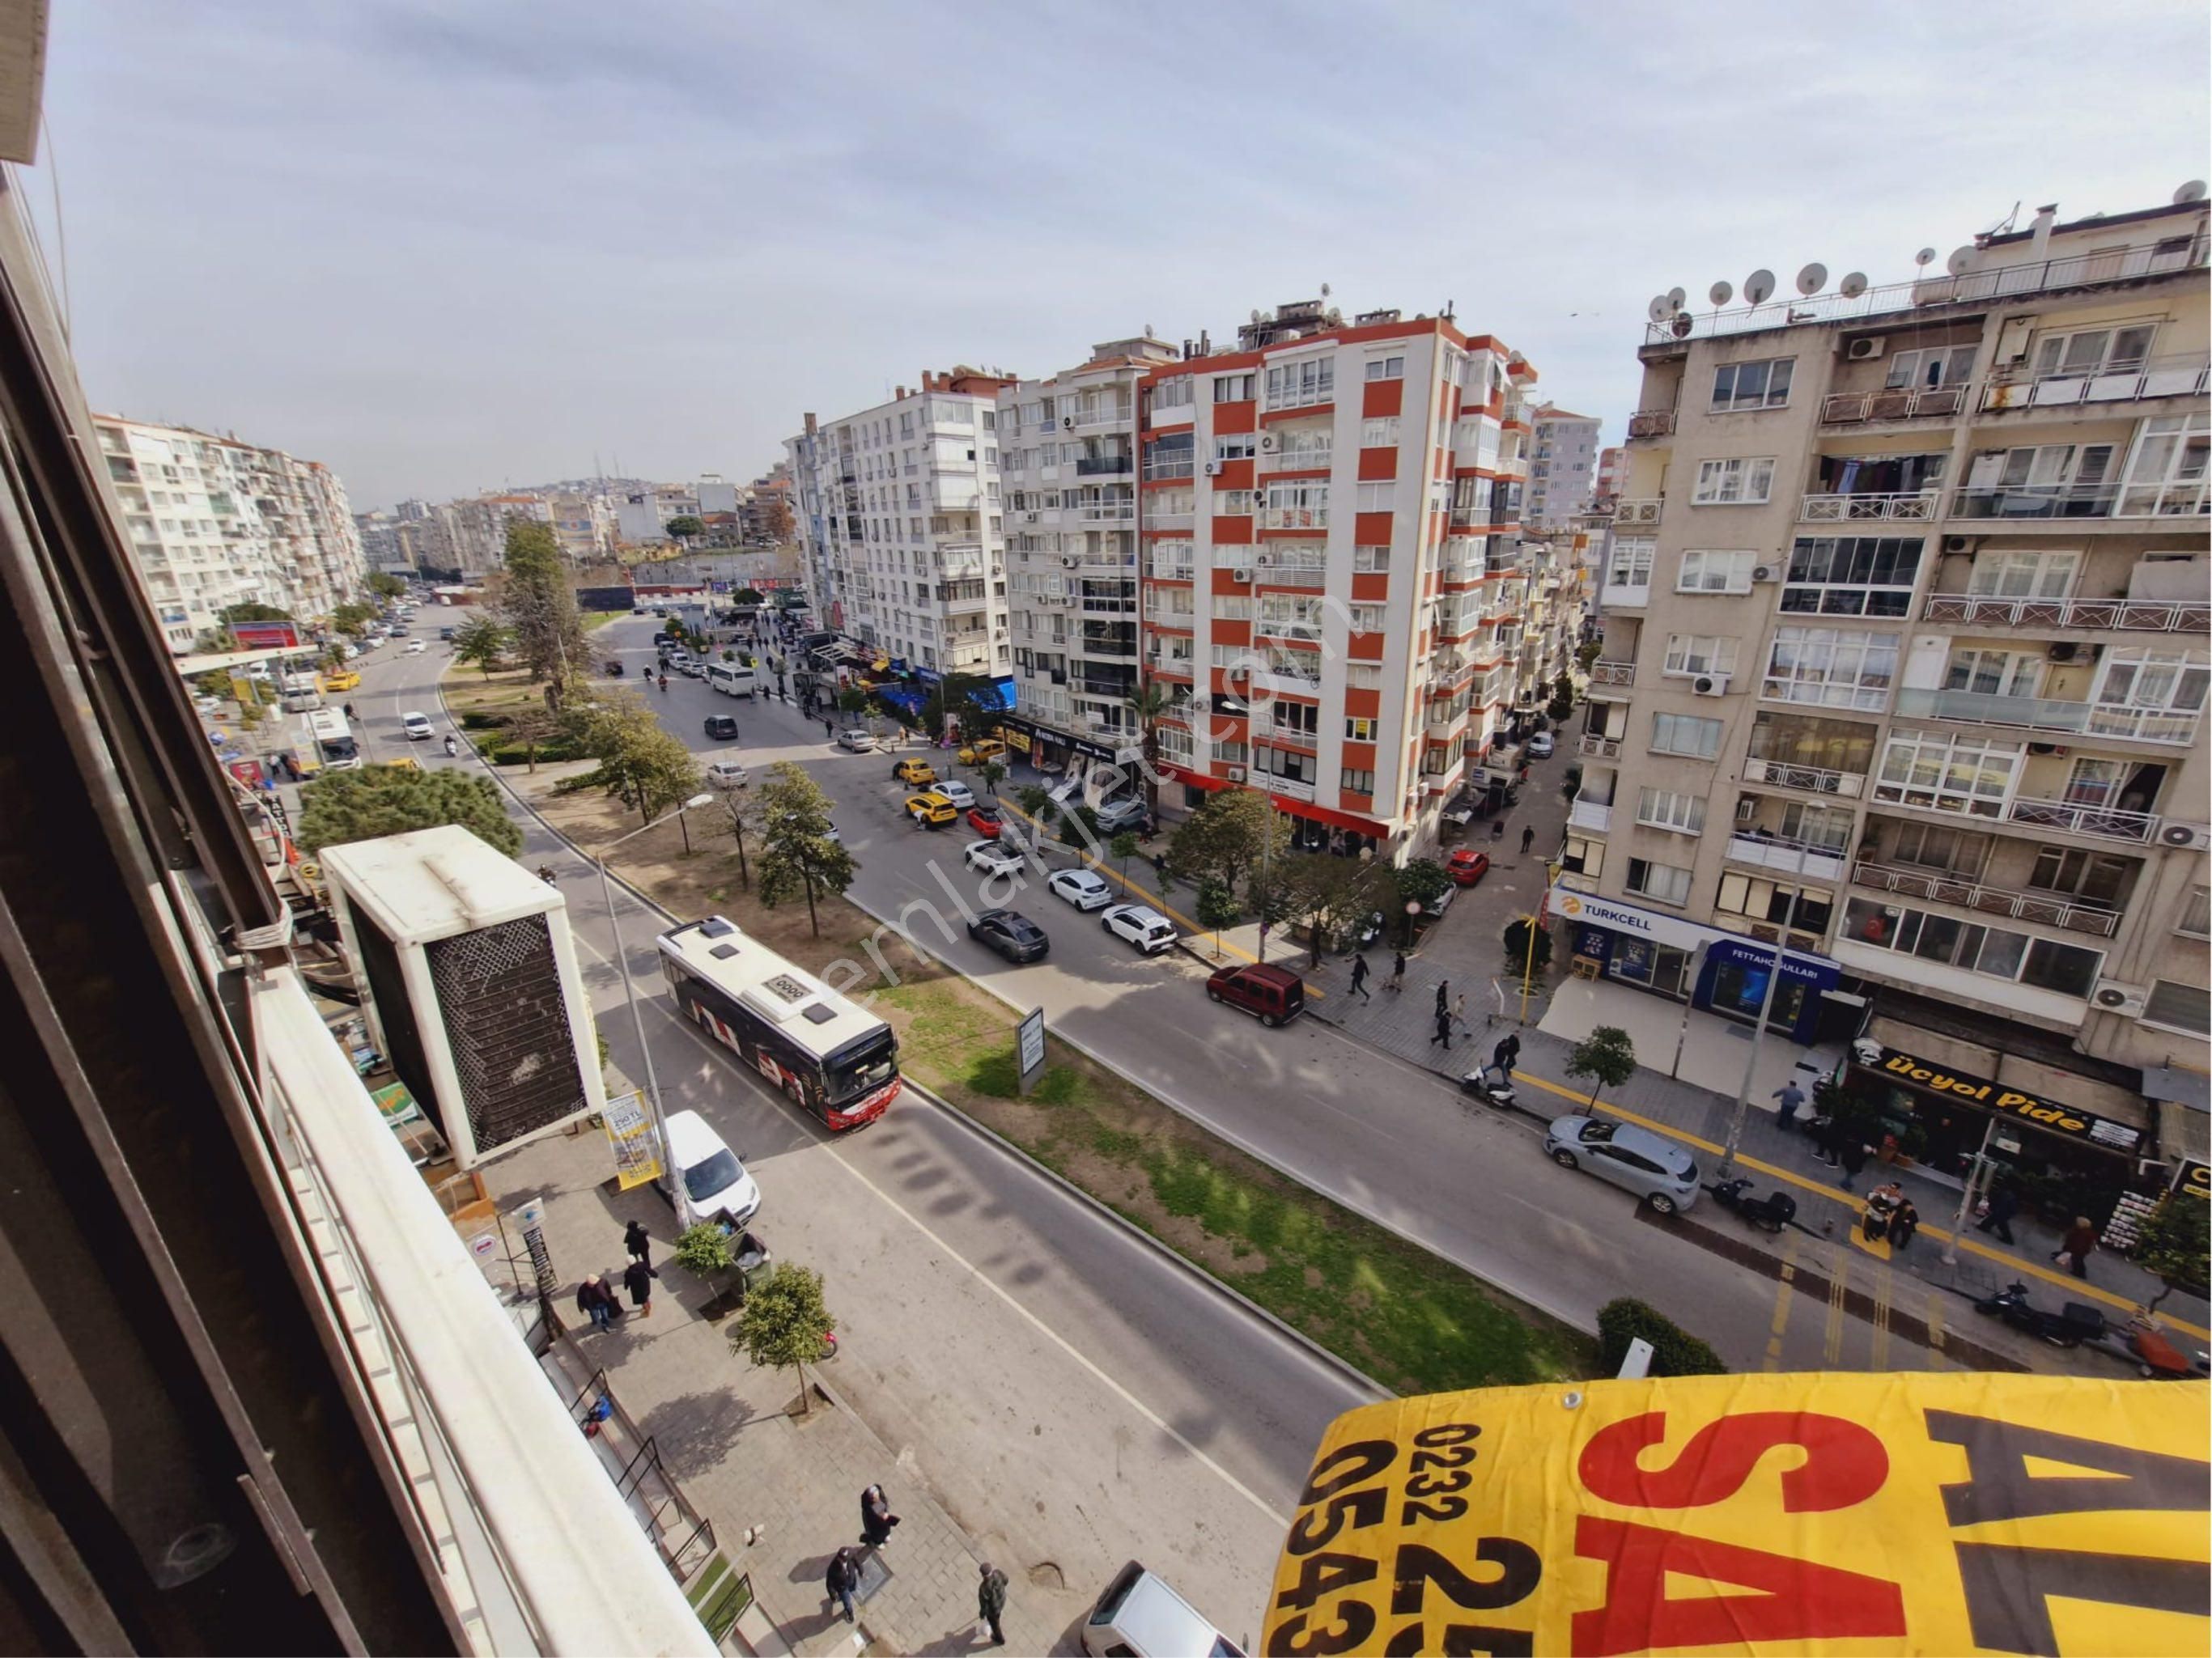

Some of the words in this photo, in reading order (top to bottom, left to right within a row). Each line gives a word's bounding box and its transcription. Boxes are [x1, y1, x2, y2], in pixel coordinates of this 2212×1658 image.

[1585, 905, 1651, 931] TURKCELL
[1997, 1092, 2085, 1130] Pide
[1401, 1424, 1482, 1526] 0232
[1267, 1440, 1399, 1658] 0543
[1571, 1411, 1907, 1658] SA
